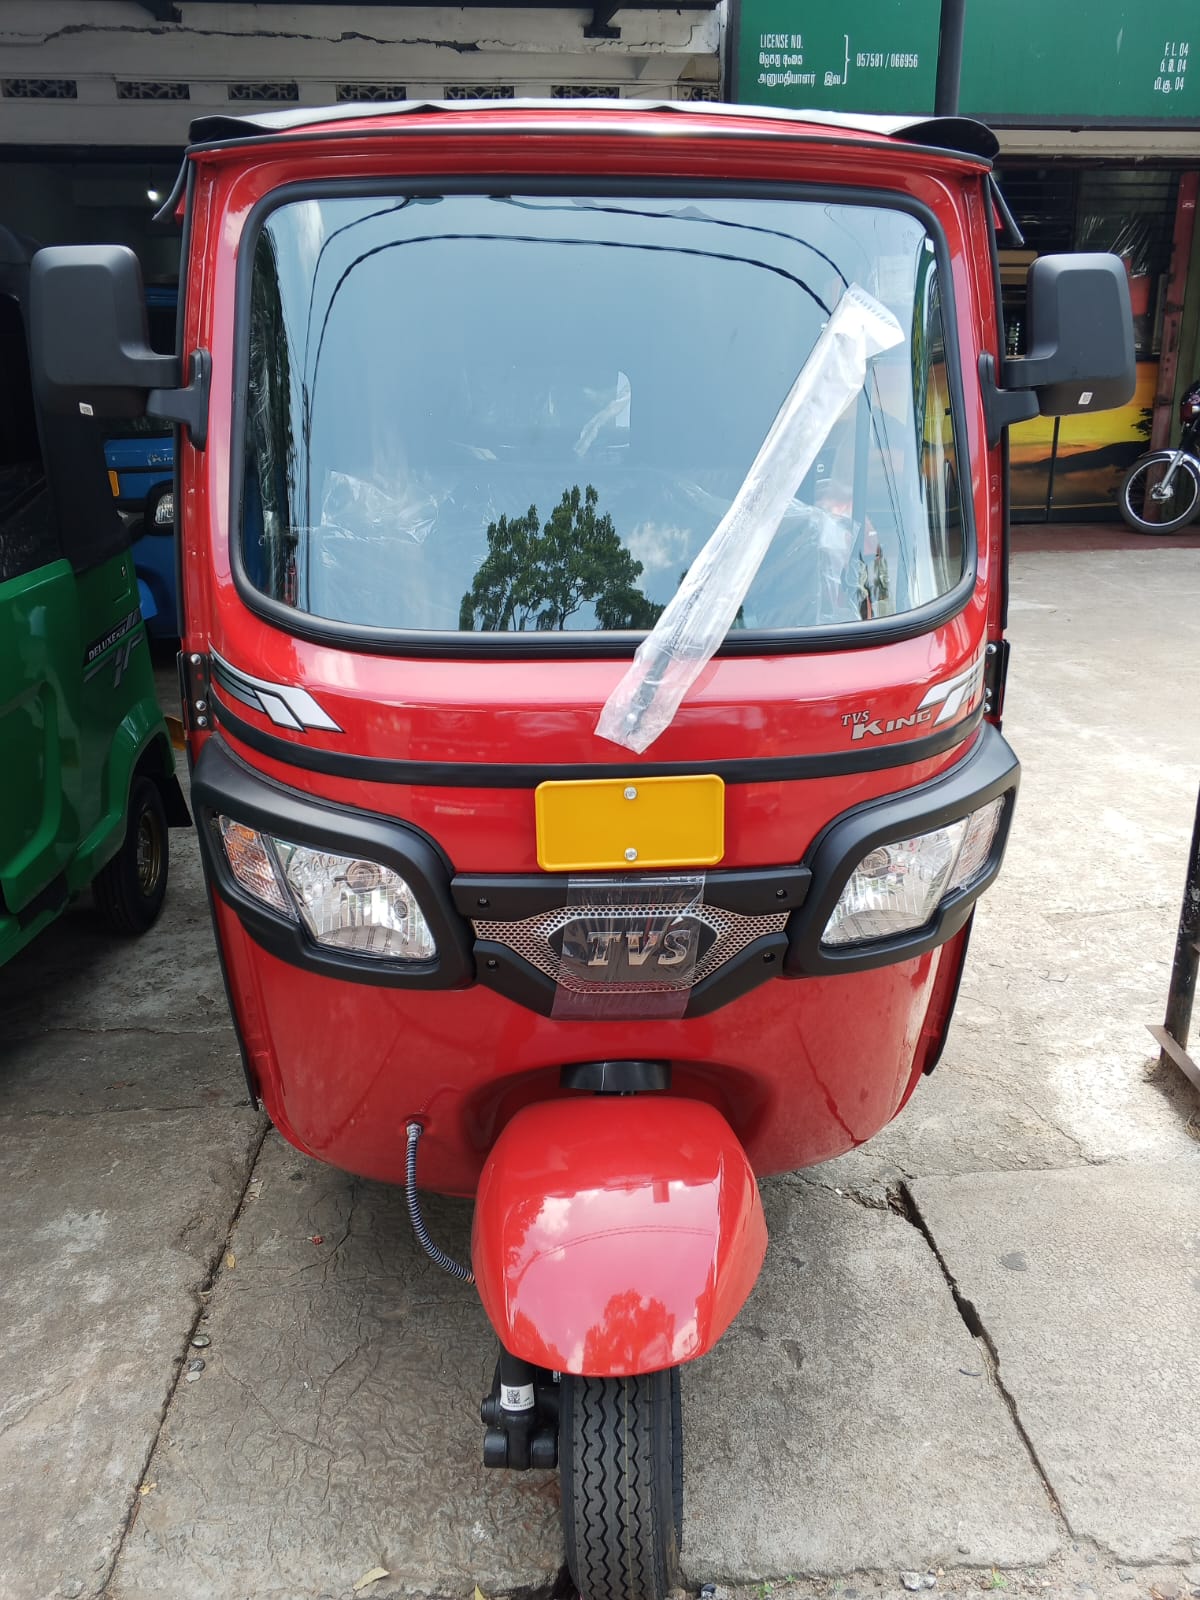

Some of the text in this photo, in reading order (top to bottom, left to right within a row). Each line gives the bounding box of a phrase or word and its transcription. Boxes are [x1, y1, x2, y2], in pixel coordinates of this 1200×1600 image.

[760, 34, 804, 49] LICENSE NO.
[1179, 42, 1189, 57] 04
[1174, 76, 1185, 91] 04
[88, 632, 117, 662] DELUXE
[841, 710, 871, 726] TVS
[586, 929, 691, 966] TVS
